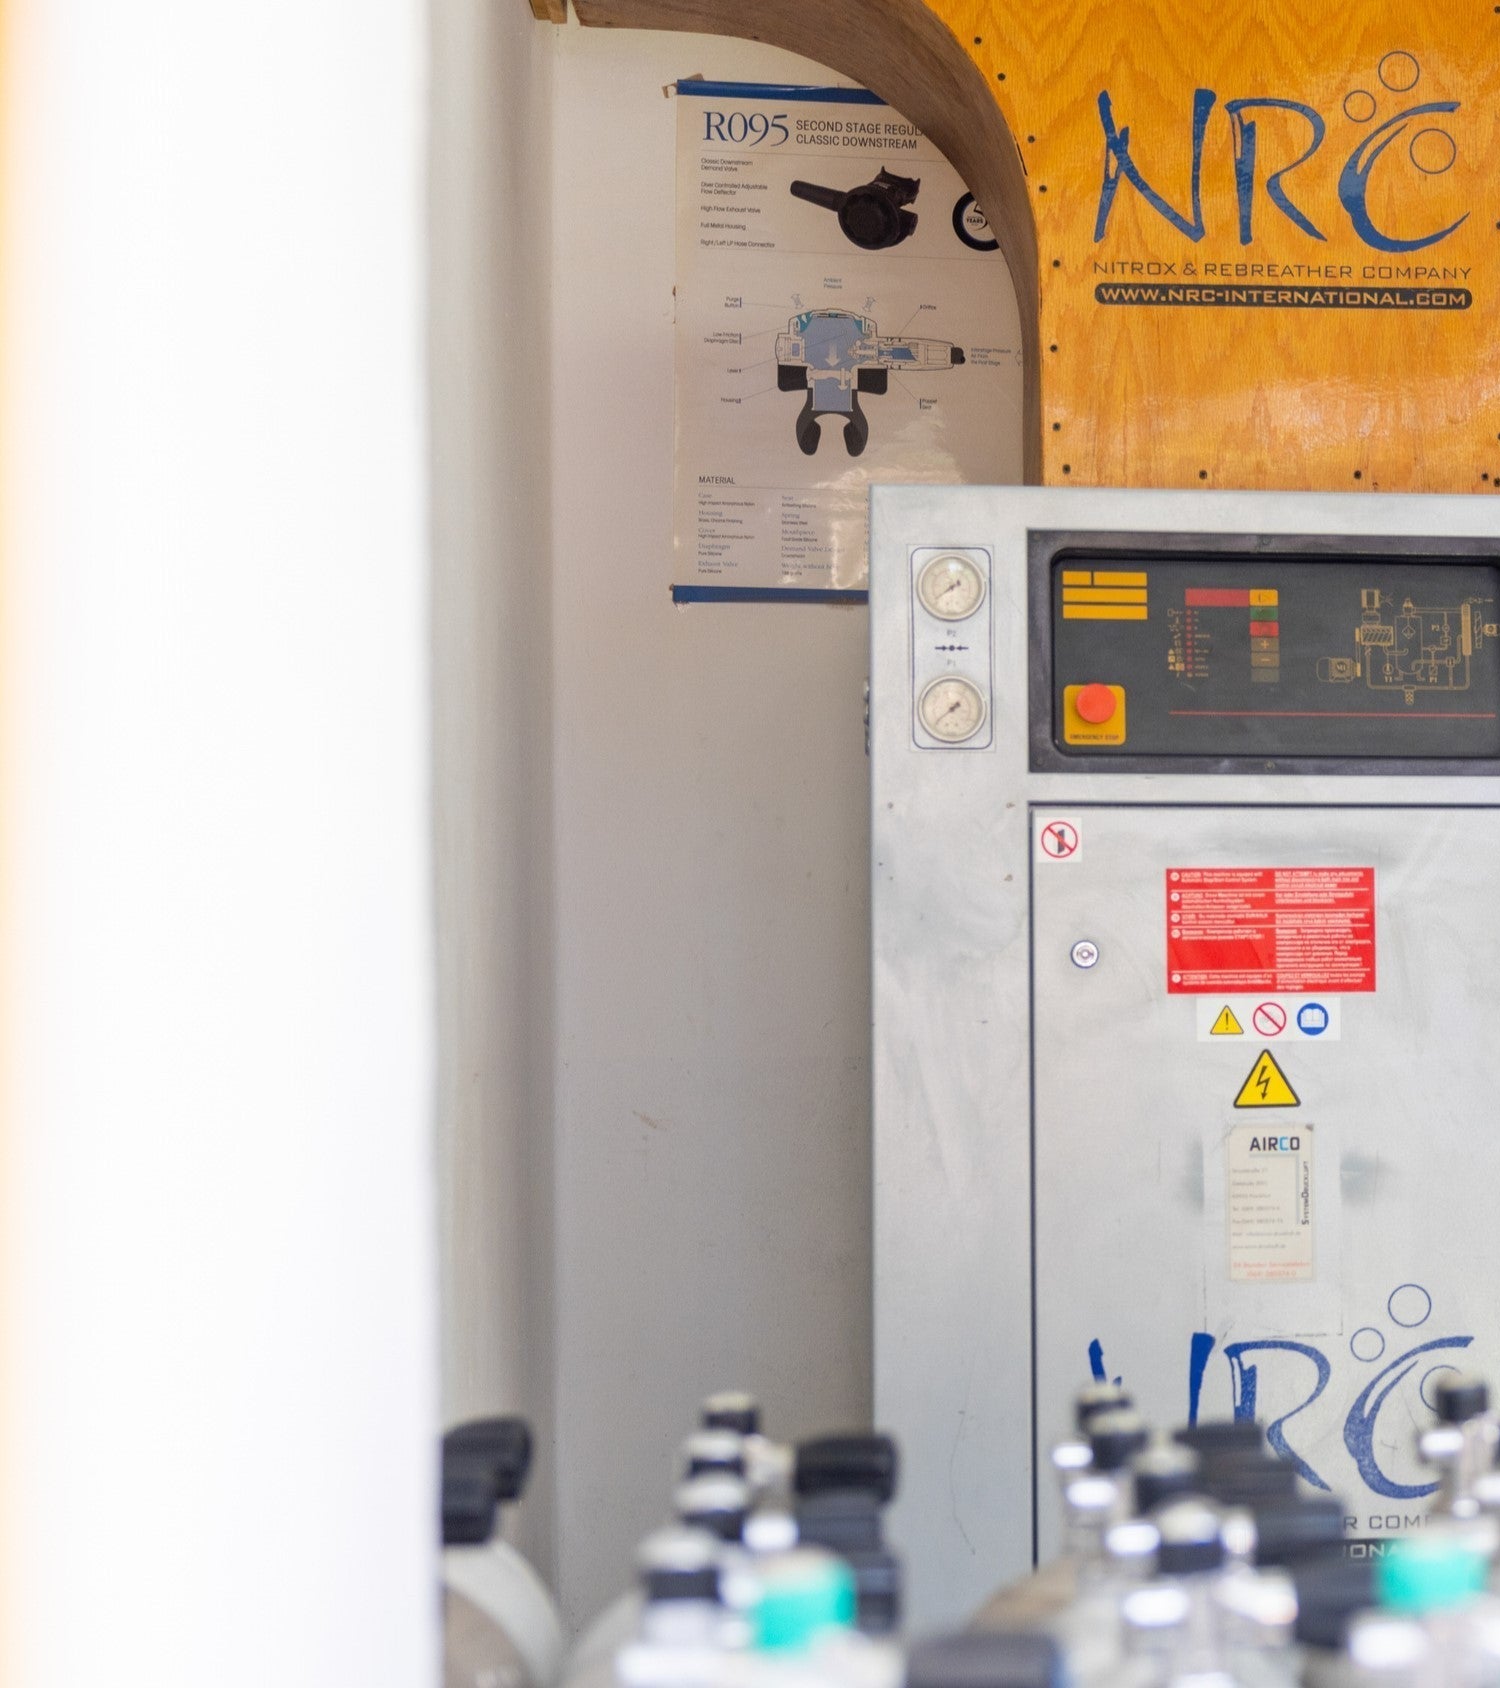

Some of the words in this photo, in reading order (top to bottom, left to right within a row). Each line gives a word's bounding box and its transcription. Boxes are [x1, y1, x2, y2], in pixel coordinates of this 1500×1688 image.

[702, 111, 790, 147] R095
[796, 119, 843, 133] SECOND
[845, 122, 881, 135] STAGE
[796, 134, 839, 146] CLASSIC
[842, 136, 917, 149] DOWNSTREAM
[1094, 88, 1470, 253] NRC
[1094, 262, 1177, 276] NITROX
[1182, 263, 1198, 276] &
[1204, 263, 1352, 279] REBREATHER
[1362, 266, 1472, 280] COMPANY
[1101, 287, 1466, 306] WWW.NRC-INTERNATIONAL.COM
[699, 476, 735, 484] MATERIAL
[1249, 1136, 1300, 1151] AIRCO
